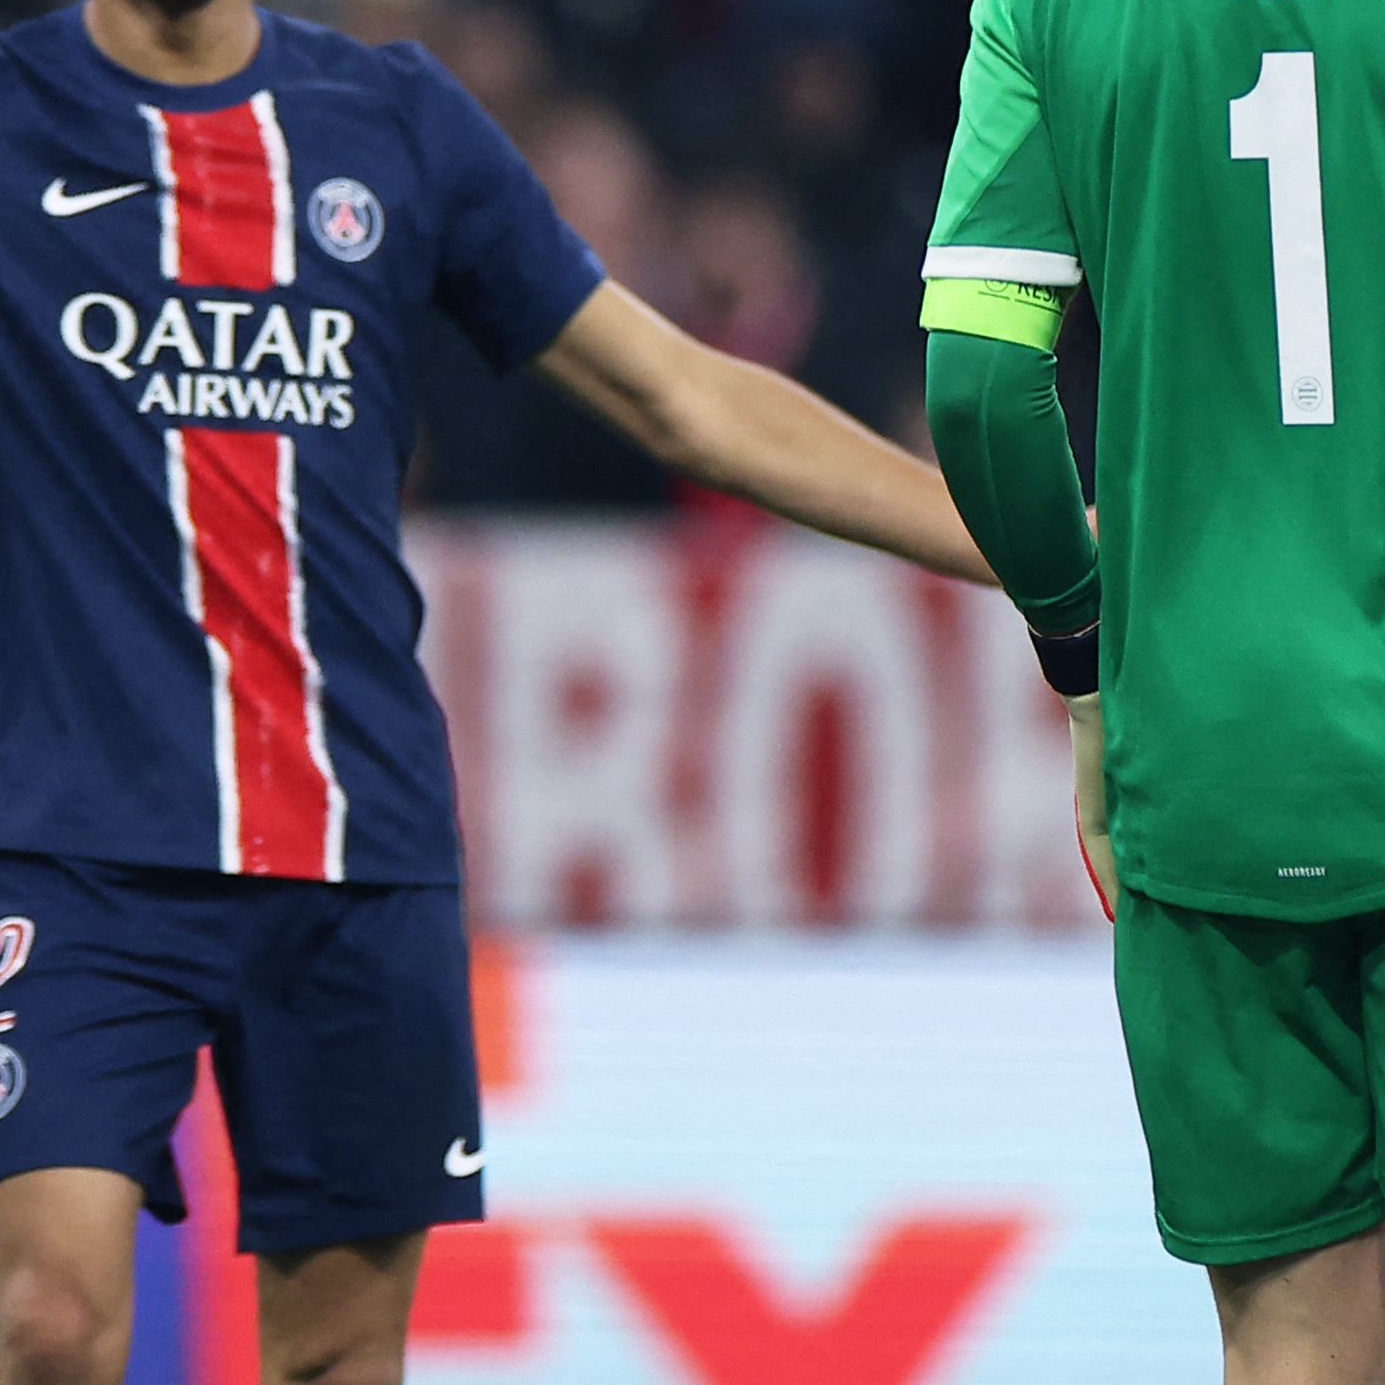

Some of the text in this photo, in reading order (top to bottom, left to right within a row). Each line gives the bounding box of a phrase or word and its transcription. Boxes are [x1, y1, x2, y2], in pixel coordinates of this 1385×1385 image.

[1227, 49, 1336, 426] 1
[59, 291, 355, 381] QATAR
[136, 372, 355, 430] AIRWAYS
